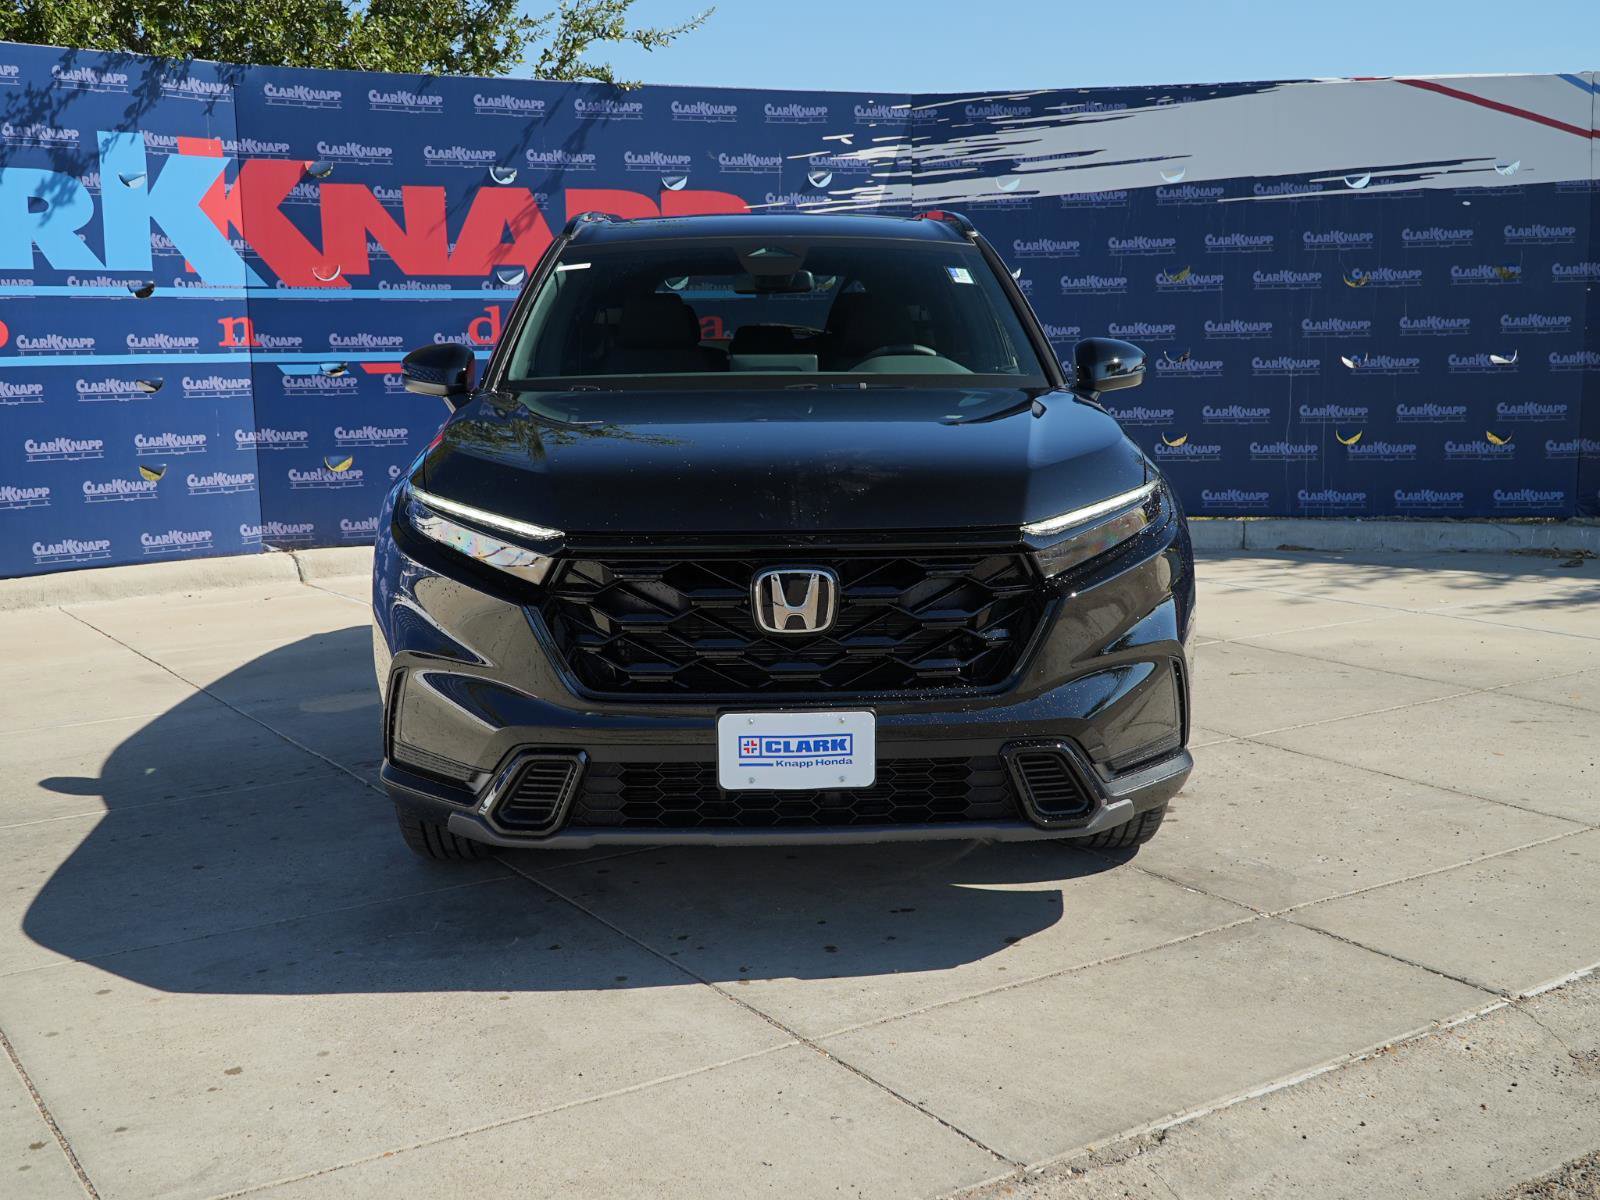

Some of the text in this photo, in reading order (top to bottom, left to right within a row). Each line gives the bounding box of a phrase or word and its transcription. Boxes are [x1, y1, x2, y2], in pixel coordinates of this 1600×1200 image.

[765, 739, 847, 753] CLARK
[776, 757, 852, 768] Knapp Honda
